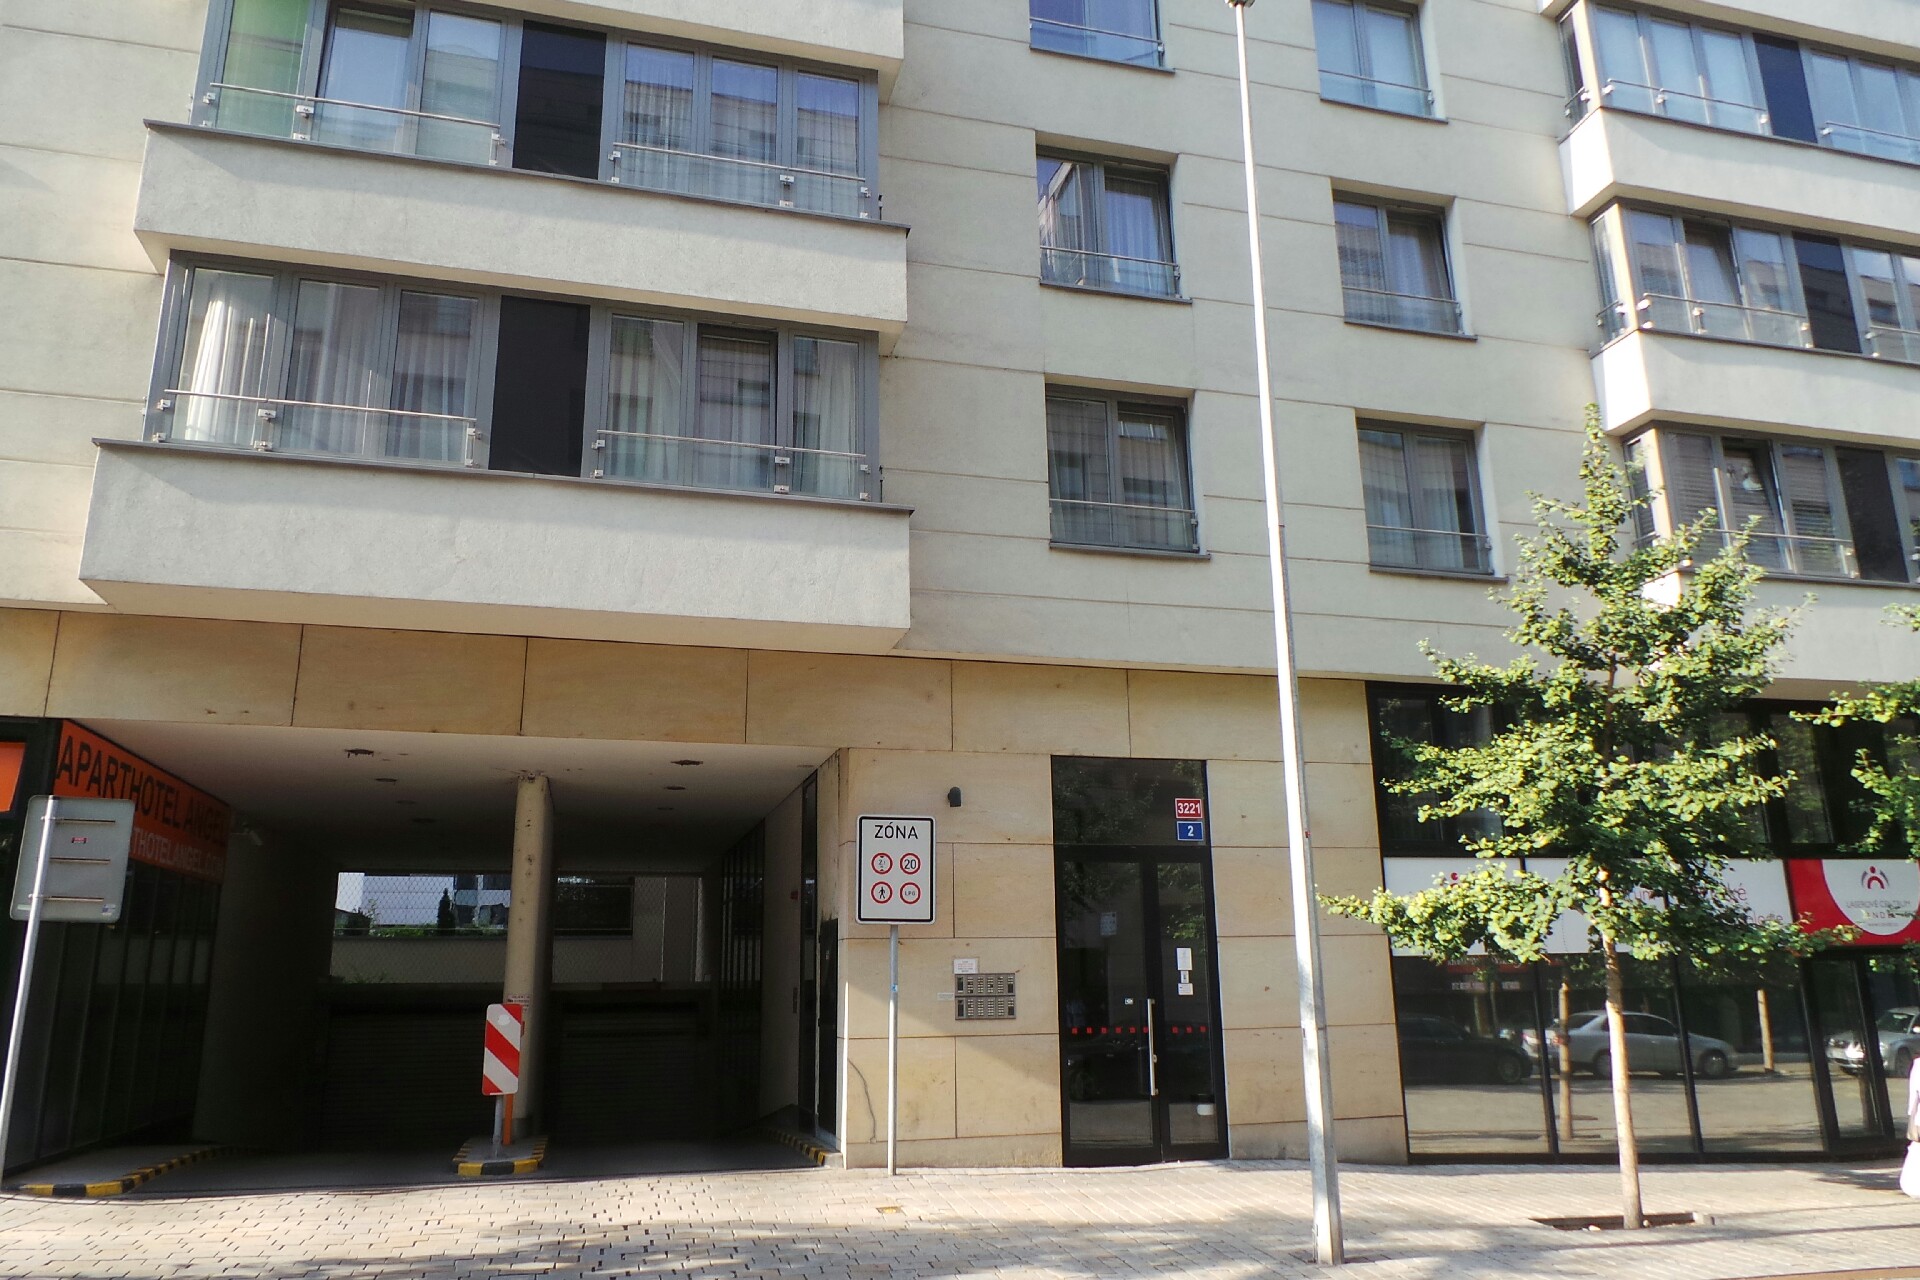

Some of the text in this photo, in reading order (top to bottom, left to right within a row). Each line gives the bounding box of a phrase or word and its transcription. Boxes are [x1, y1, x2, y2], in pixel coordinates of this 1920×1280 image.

[56, 735, 227, 846] APARTHOTEL ANGEL
[1177, 803, 1201, 814] 3221
[874, 822, 918, 840] ZÓNA
[1187, 825, 1194, 837] 2
[904, 859, 917, 870] 20
